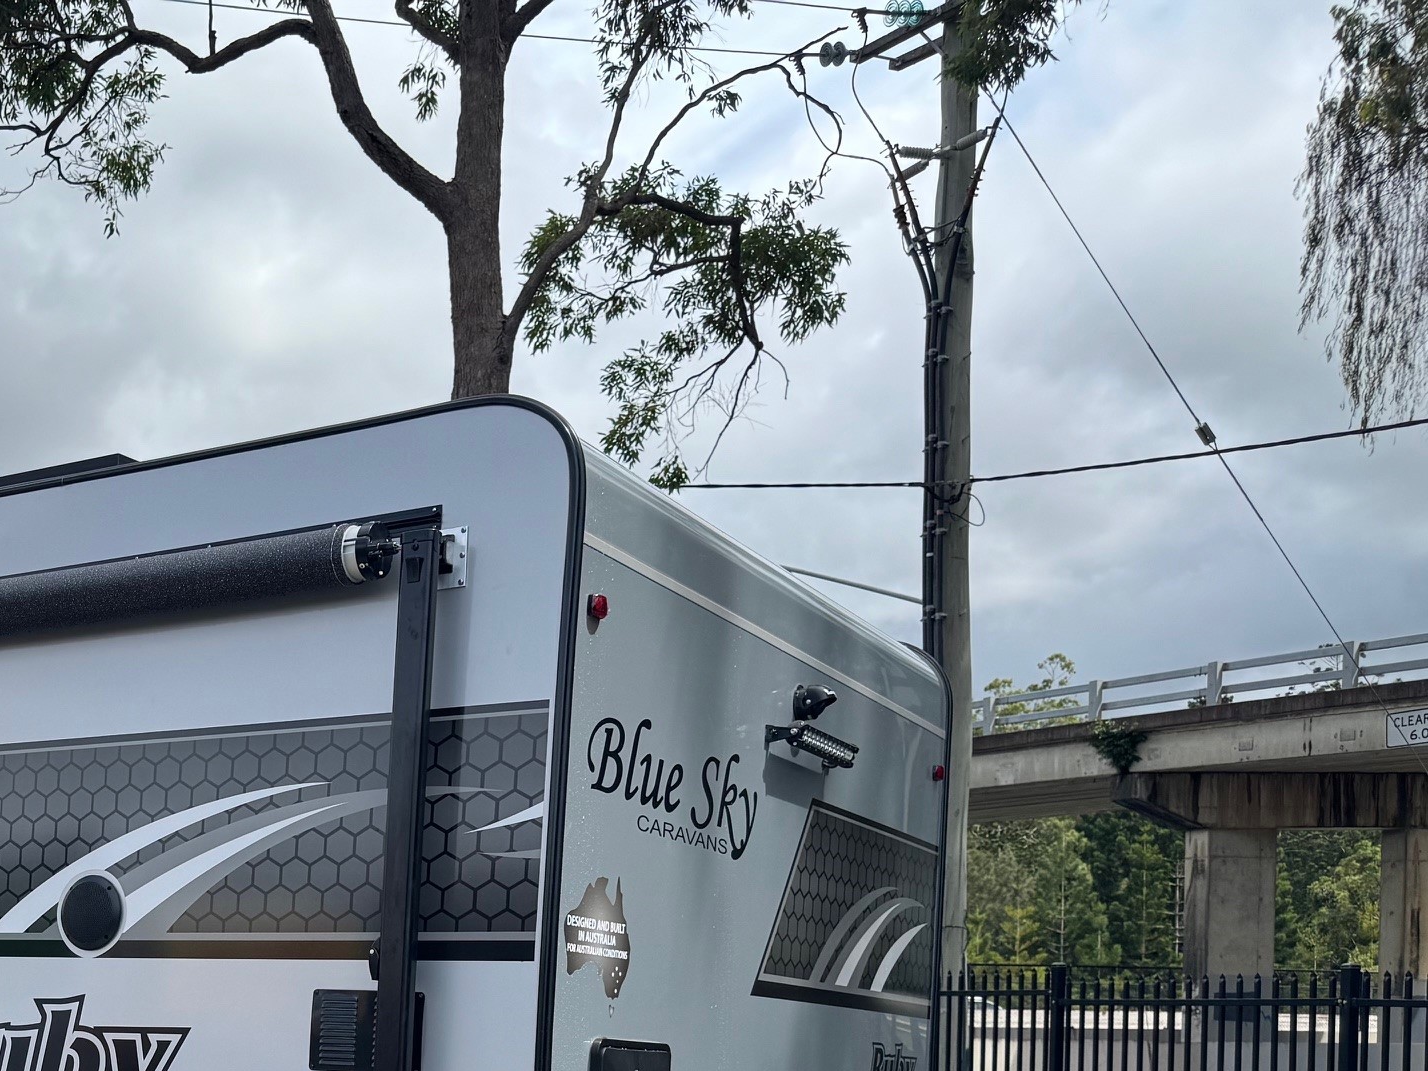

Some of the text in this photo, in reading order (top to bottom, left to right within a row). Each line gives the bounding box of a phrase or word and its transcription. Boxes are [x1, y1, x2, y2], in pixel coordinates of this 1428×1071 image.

[587, 717, 758, 860] Blue Sky
[637, 815, 728, 855] CARAVANS
[567, 914, 626, 935] DESIGNED AND BUILT
[578, 930, 616, 947] IN AUSTRALIA
[567, 943, 628, 960] FOR AUSTRALIAN CONDITIONS
